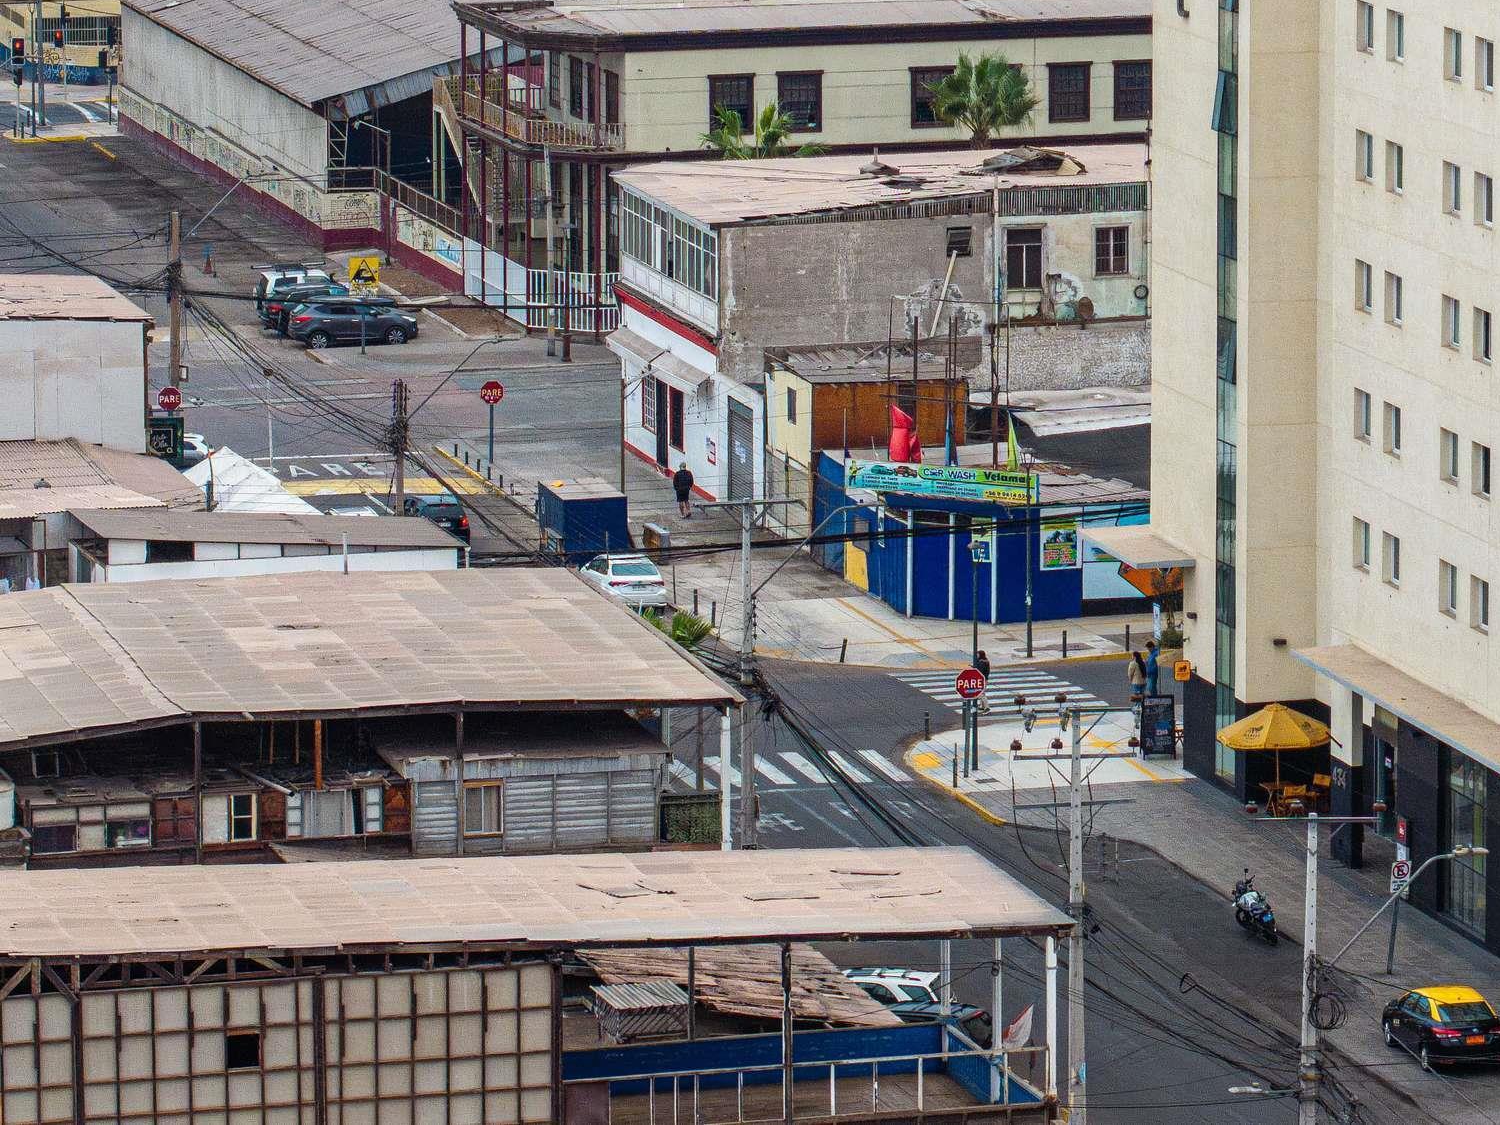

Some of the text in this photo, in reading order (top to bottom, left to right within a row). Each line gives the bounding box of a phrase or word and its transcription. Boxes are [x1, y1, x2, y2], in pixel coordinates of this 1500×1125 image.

[481, 388, 502, 397] PARE
[159, 395, 180, 403] PARE
[948, 470, 976, 480] WASH
[983, 471, 1031, 483] Velama
[957, 678, 983, 689] PARE
